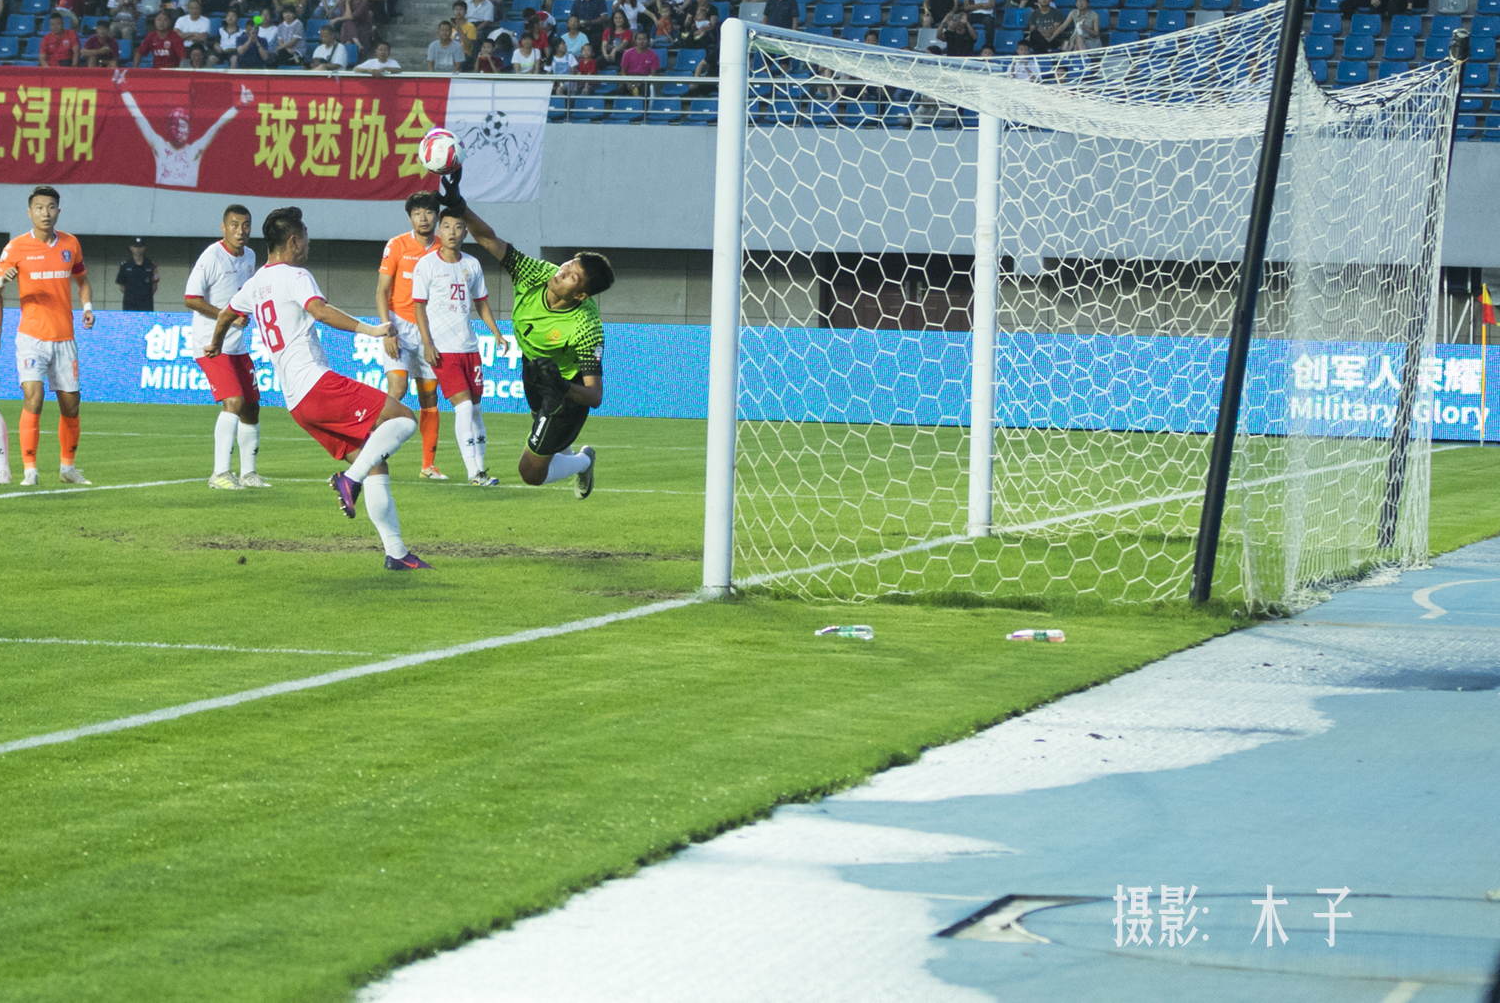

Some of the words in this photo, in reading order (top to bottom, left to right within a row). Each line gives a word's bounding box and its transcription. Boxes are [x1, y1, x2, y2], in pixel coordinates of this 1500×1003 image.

[253, 96, 436, 180] 球迷协会
[450, 283, 466, 301] 25
[255, 299, 285, 353] 18
[141, 365, 210, 390] Milita
[473, 365, 483, 384] 2
[1290, 395, 1399, 428] Military
[1413, 398, 1490, 431] Glory
[534, 416, 547, 437] 1
